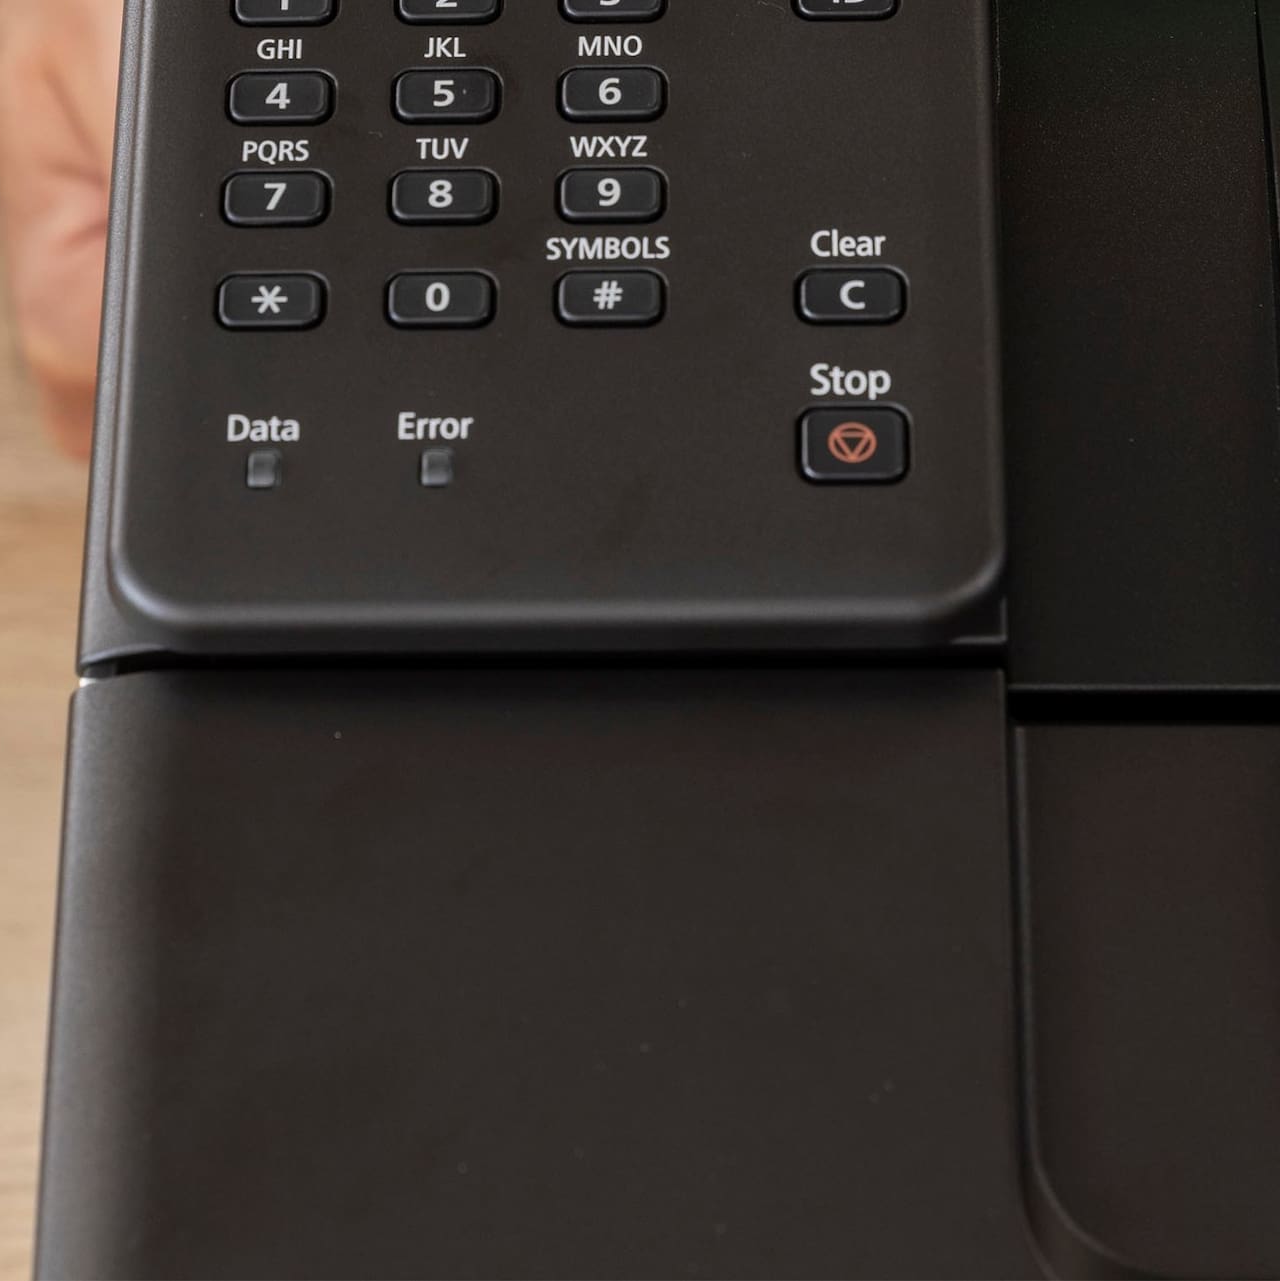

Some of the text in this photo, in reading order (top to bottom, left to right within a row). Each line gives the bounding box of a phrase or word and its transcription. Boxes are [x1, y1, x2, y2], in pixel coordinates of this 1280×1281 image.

[256, 38, 302, 60] GHI
[423, 36, 467, 58] JKL
[578, 35, 643, 57] MNO
[265, 82, 291, 110] 4
[433, 79, 455, 107] 5
[598, 77, 622, 105] 6
[242, 139, 309, 165] PQRS
[415, 137, 469, 160] TUV
[569, 135, 648, 158] WXYZ
[263, 182, 287, 211] 7
[428, 179, 453, 208] 8
[597, 177, 621, 207] 9
[546, 236, 671, 261] SYMBOLS
[810, 228, 886, 257] Clear
[425, 282, 450, 312] 0
[593, 280, 623, 310] #
[839, 280, 866, 310] C
[810, 363, 891, 401] Stop
[227, 414, 300, 442] Data
[397, 411, 474, 440] Error
